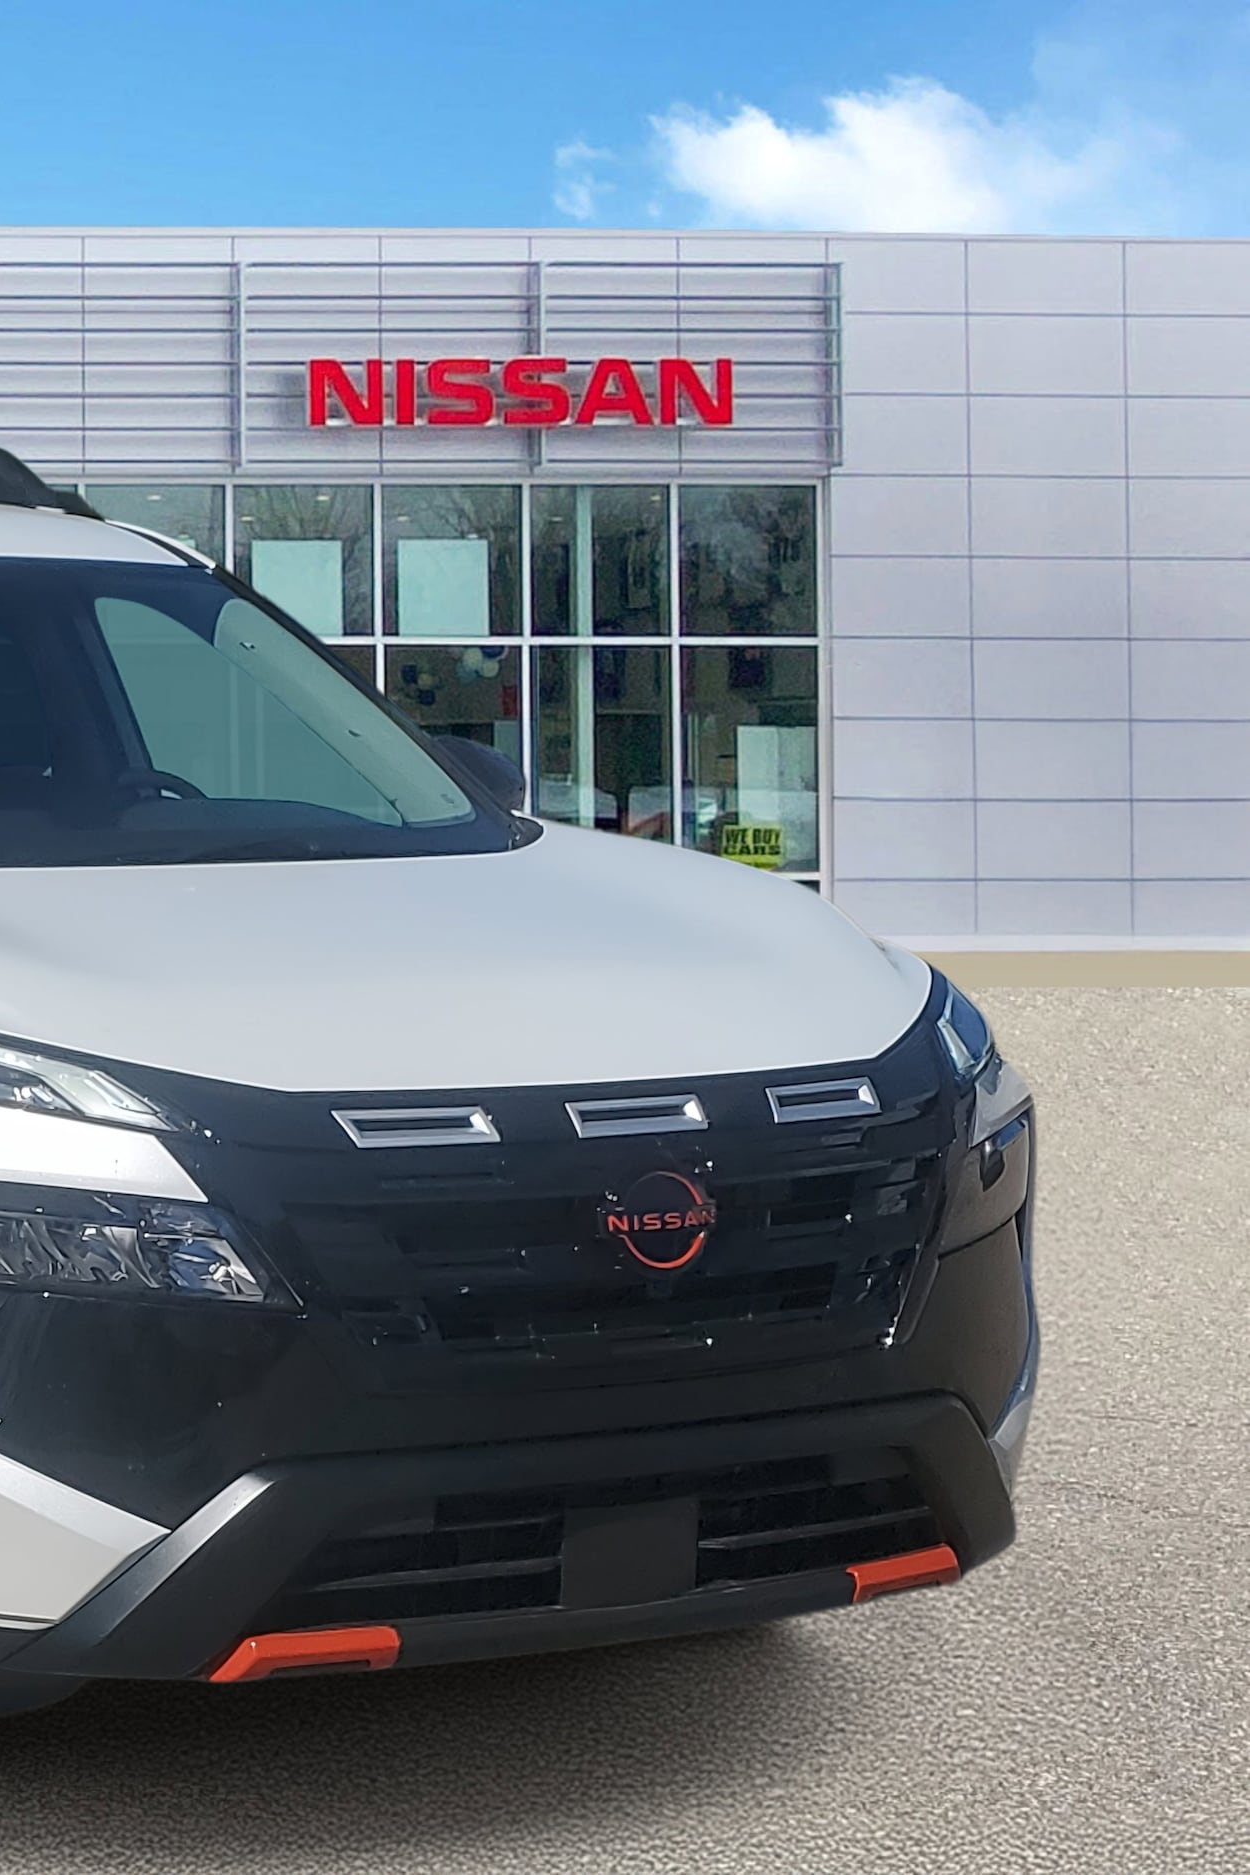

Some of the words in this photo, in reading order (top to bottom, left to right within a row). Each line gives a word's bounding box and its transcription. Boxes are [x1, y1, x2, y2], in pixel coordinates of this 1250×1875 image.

[308, 357, 733, 427] NISSAN
[724, 828, 748, 844] WE
[752, 828, 781, 844] BUY
[723, 845, 781, 855] CARS
[607, 1210, 715, 1232] NISSAN
